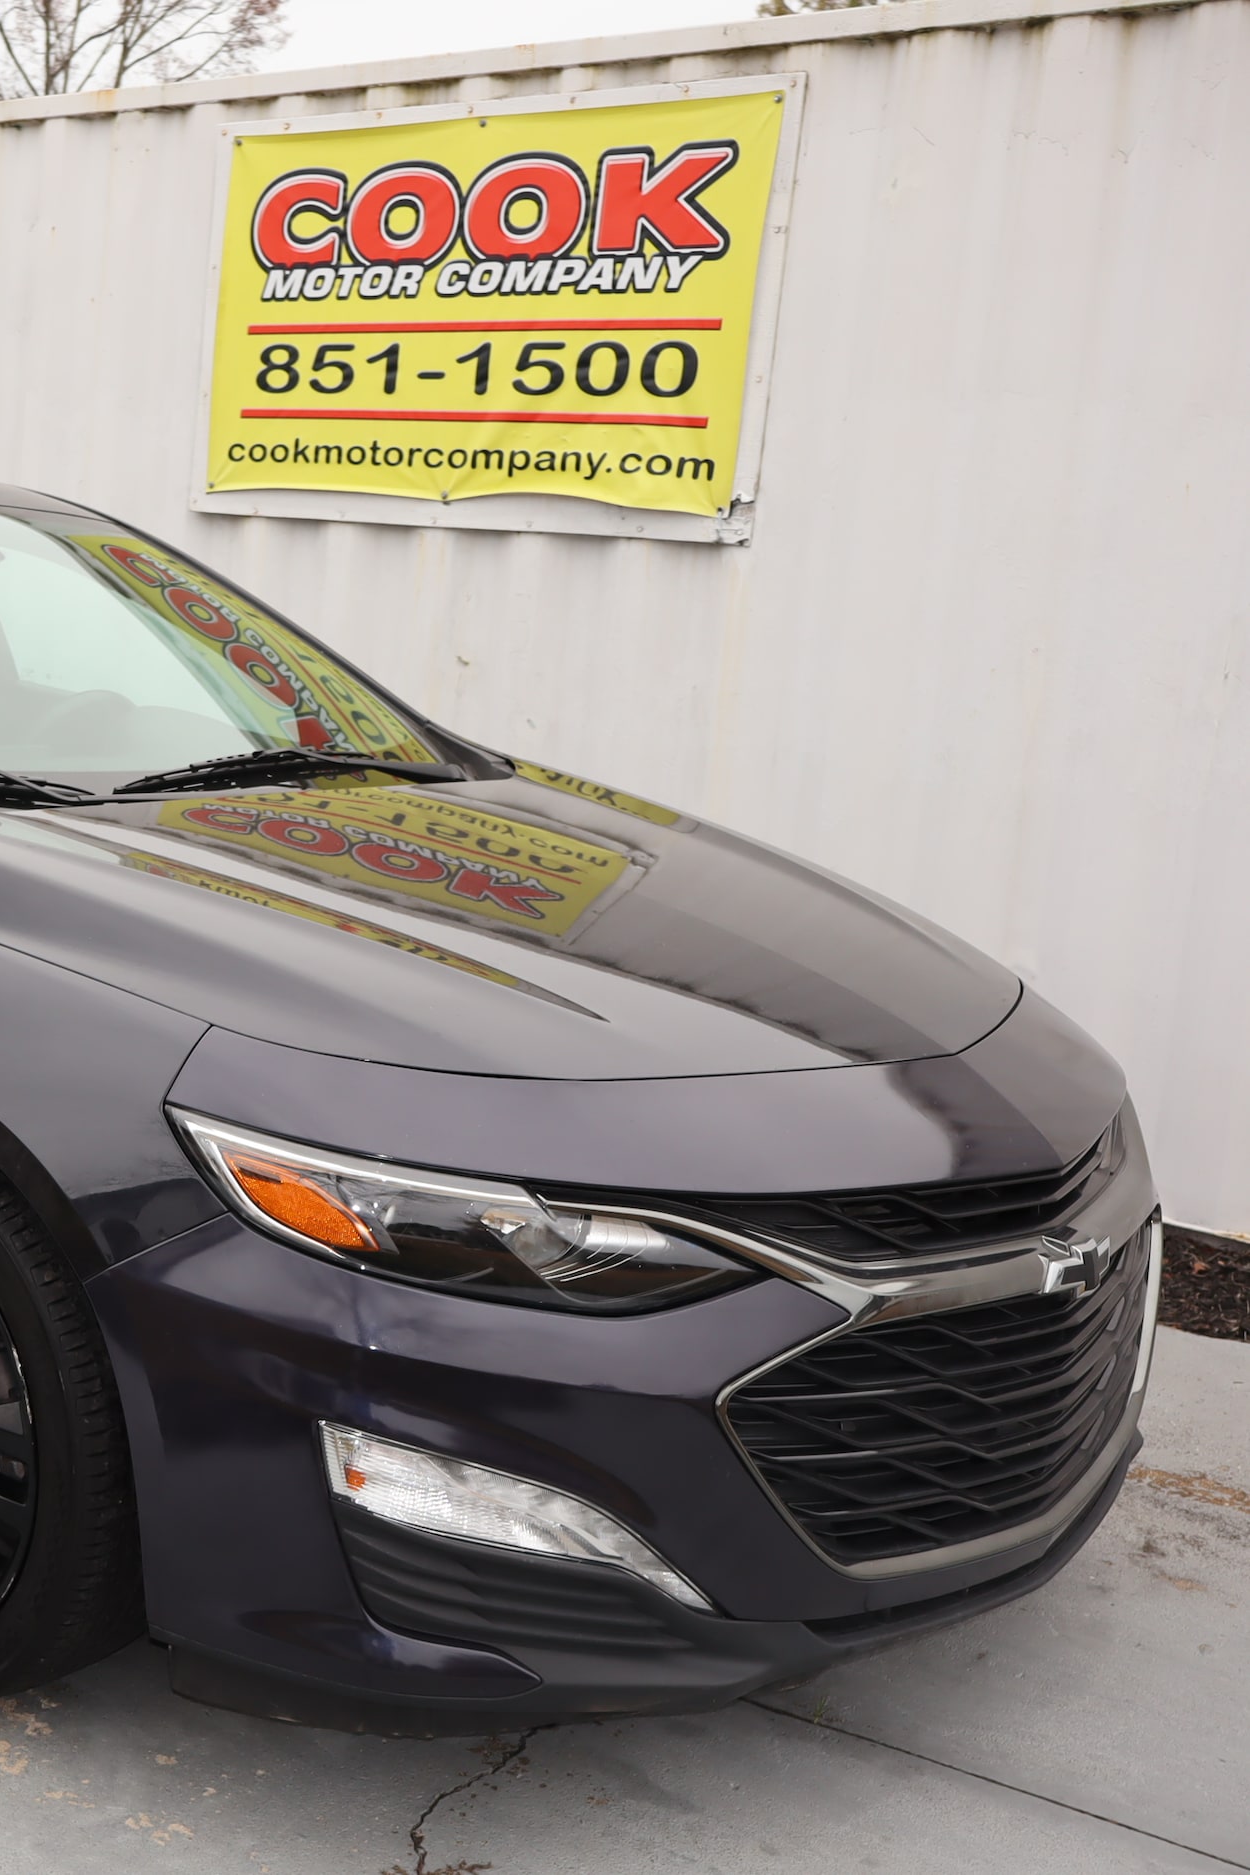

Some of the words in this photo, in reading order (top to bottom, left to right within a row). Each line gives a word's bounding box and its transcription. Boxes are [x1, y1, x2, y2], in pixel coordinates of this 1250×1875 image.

[252, 139, 739, 268] COOK
[261, 263, 421, 300] MOTOR
[434, 255, 703, 296] COMPANY
[255, 341, 699, 397] 851-1500
[227, 438, 716, 481] cookmotorcompany.com
